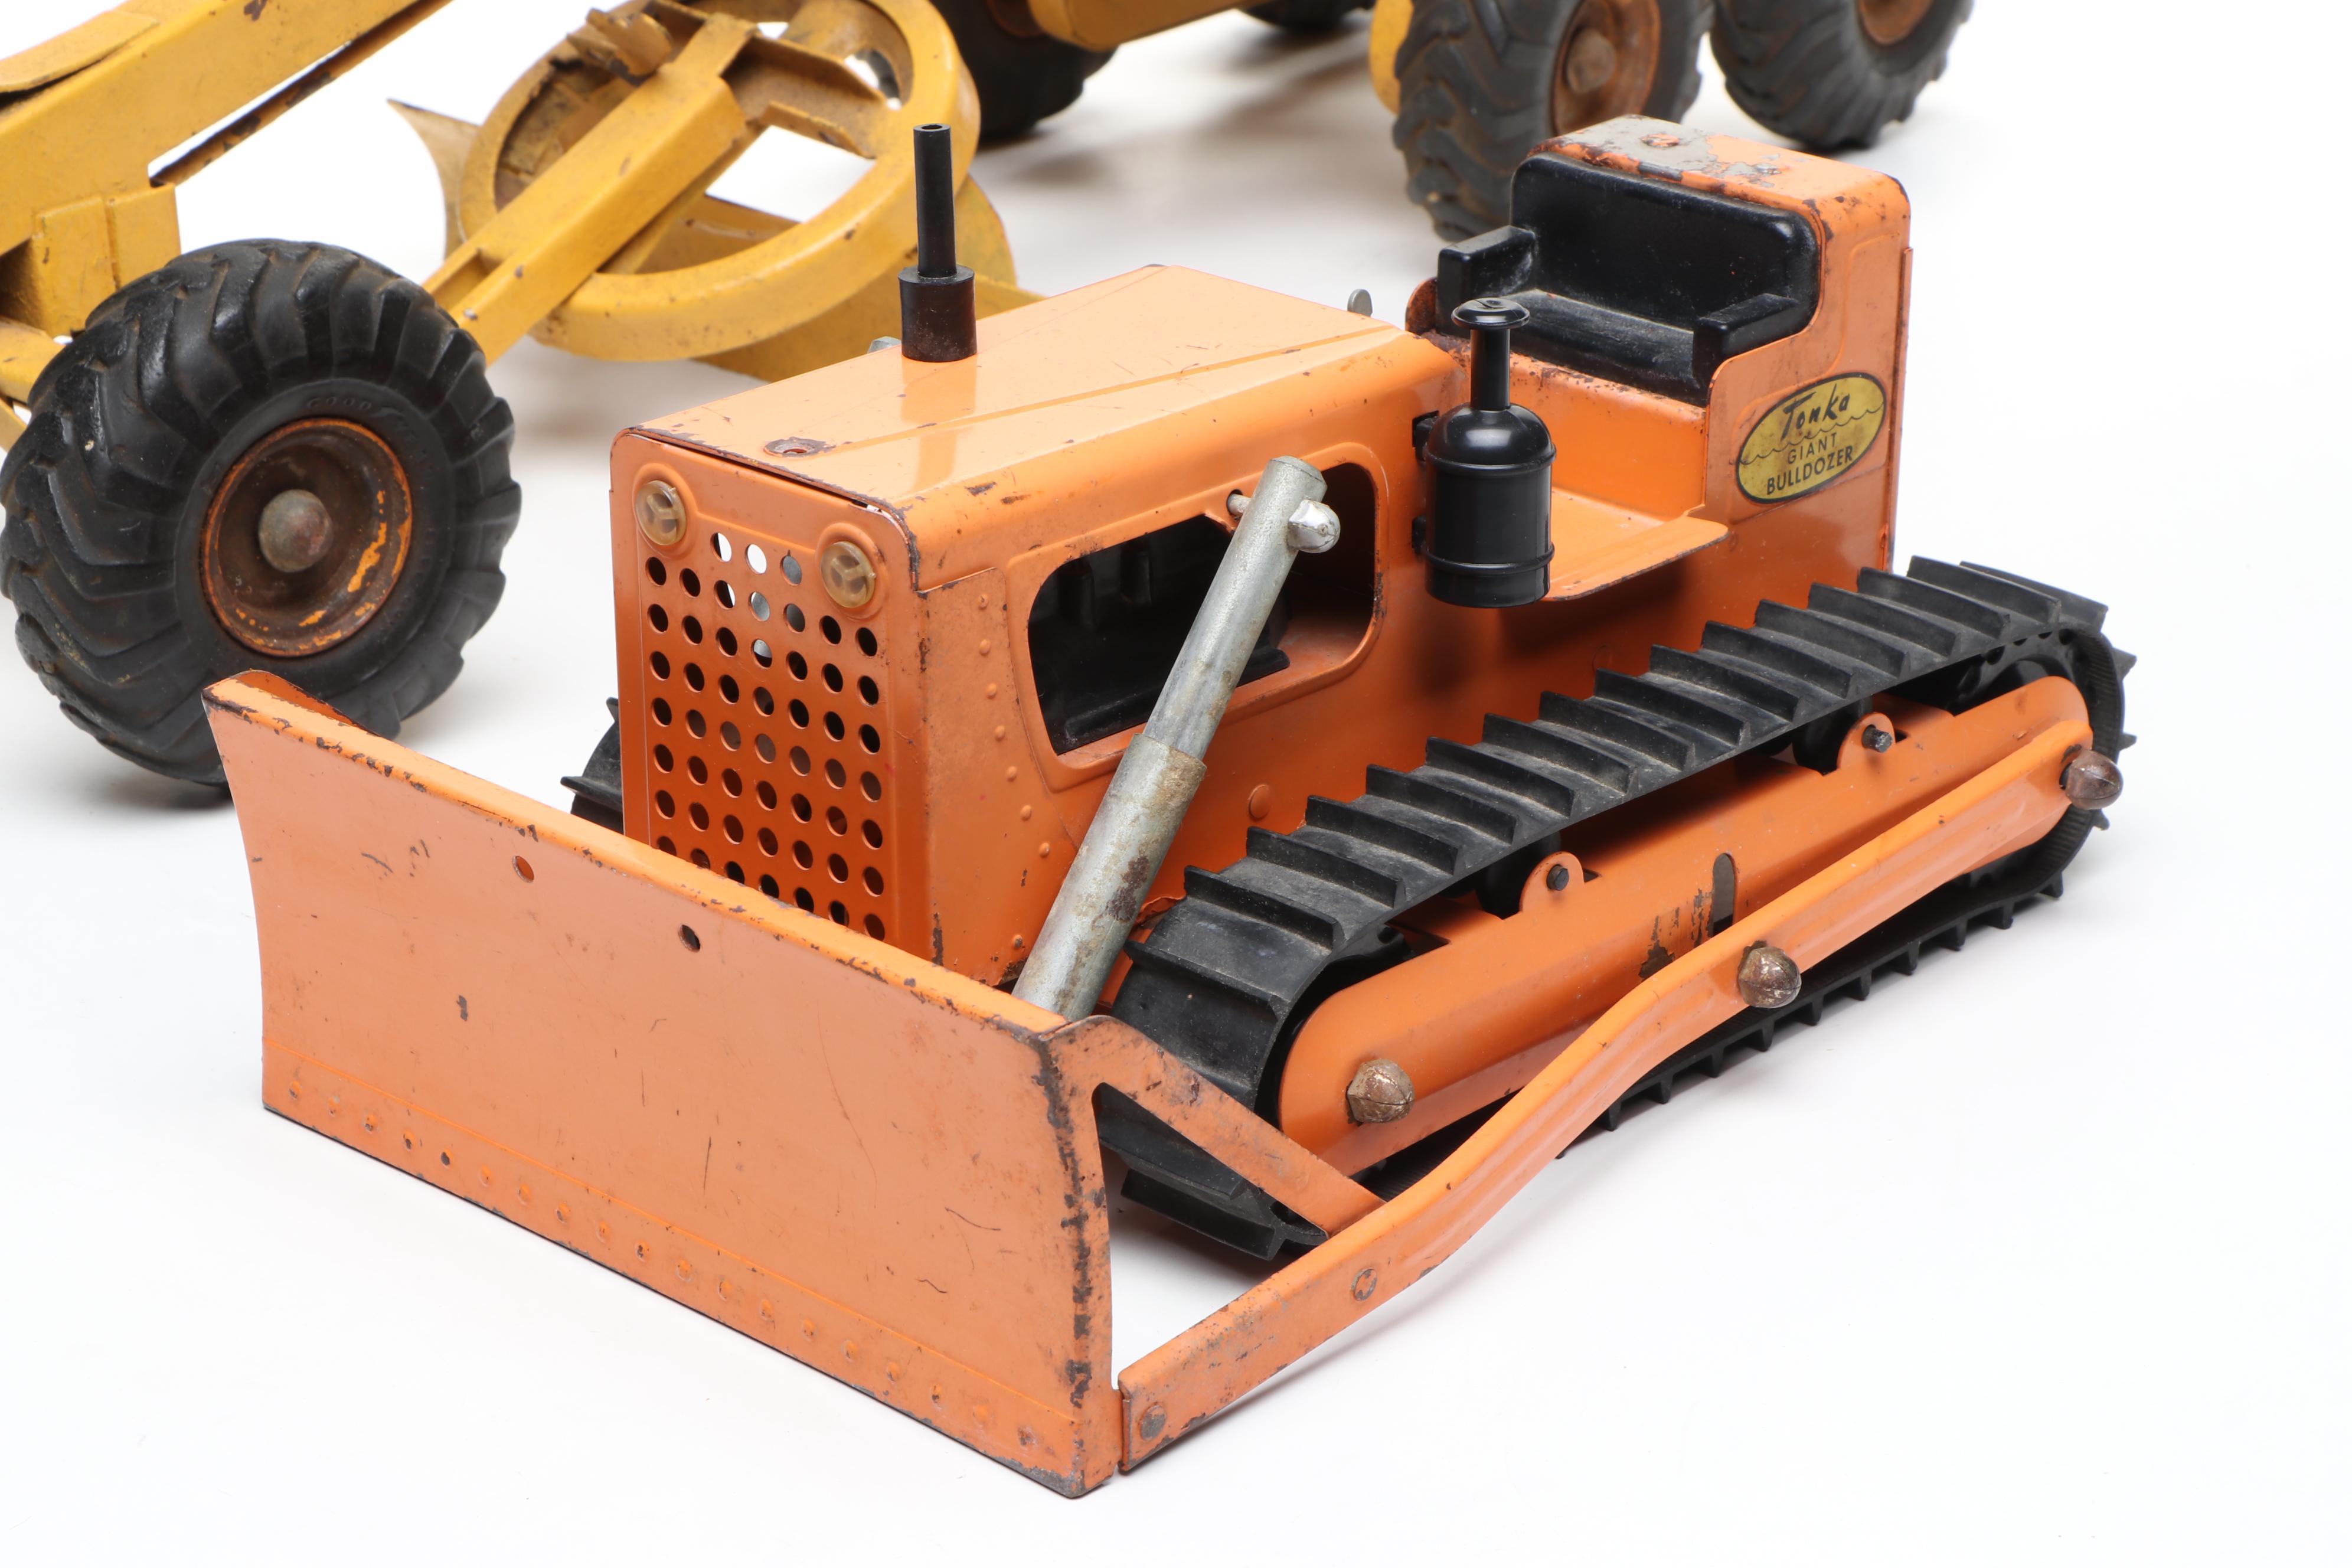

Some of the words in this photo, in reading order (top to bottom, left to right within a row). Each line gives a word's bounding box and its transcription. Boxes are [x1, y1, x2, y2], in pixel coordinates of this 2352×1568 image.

[1781, 384, 1850, 441] Tonka
[1767, 446, 1853, 495] BULLDOZER
[1788, 433, 1837, 464] GIANT
